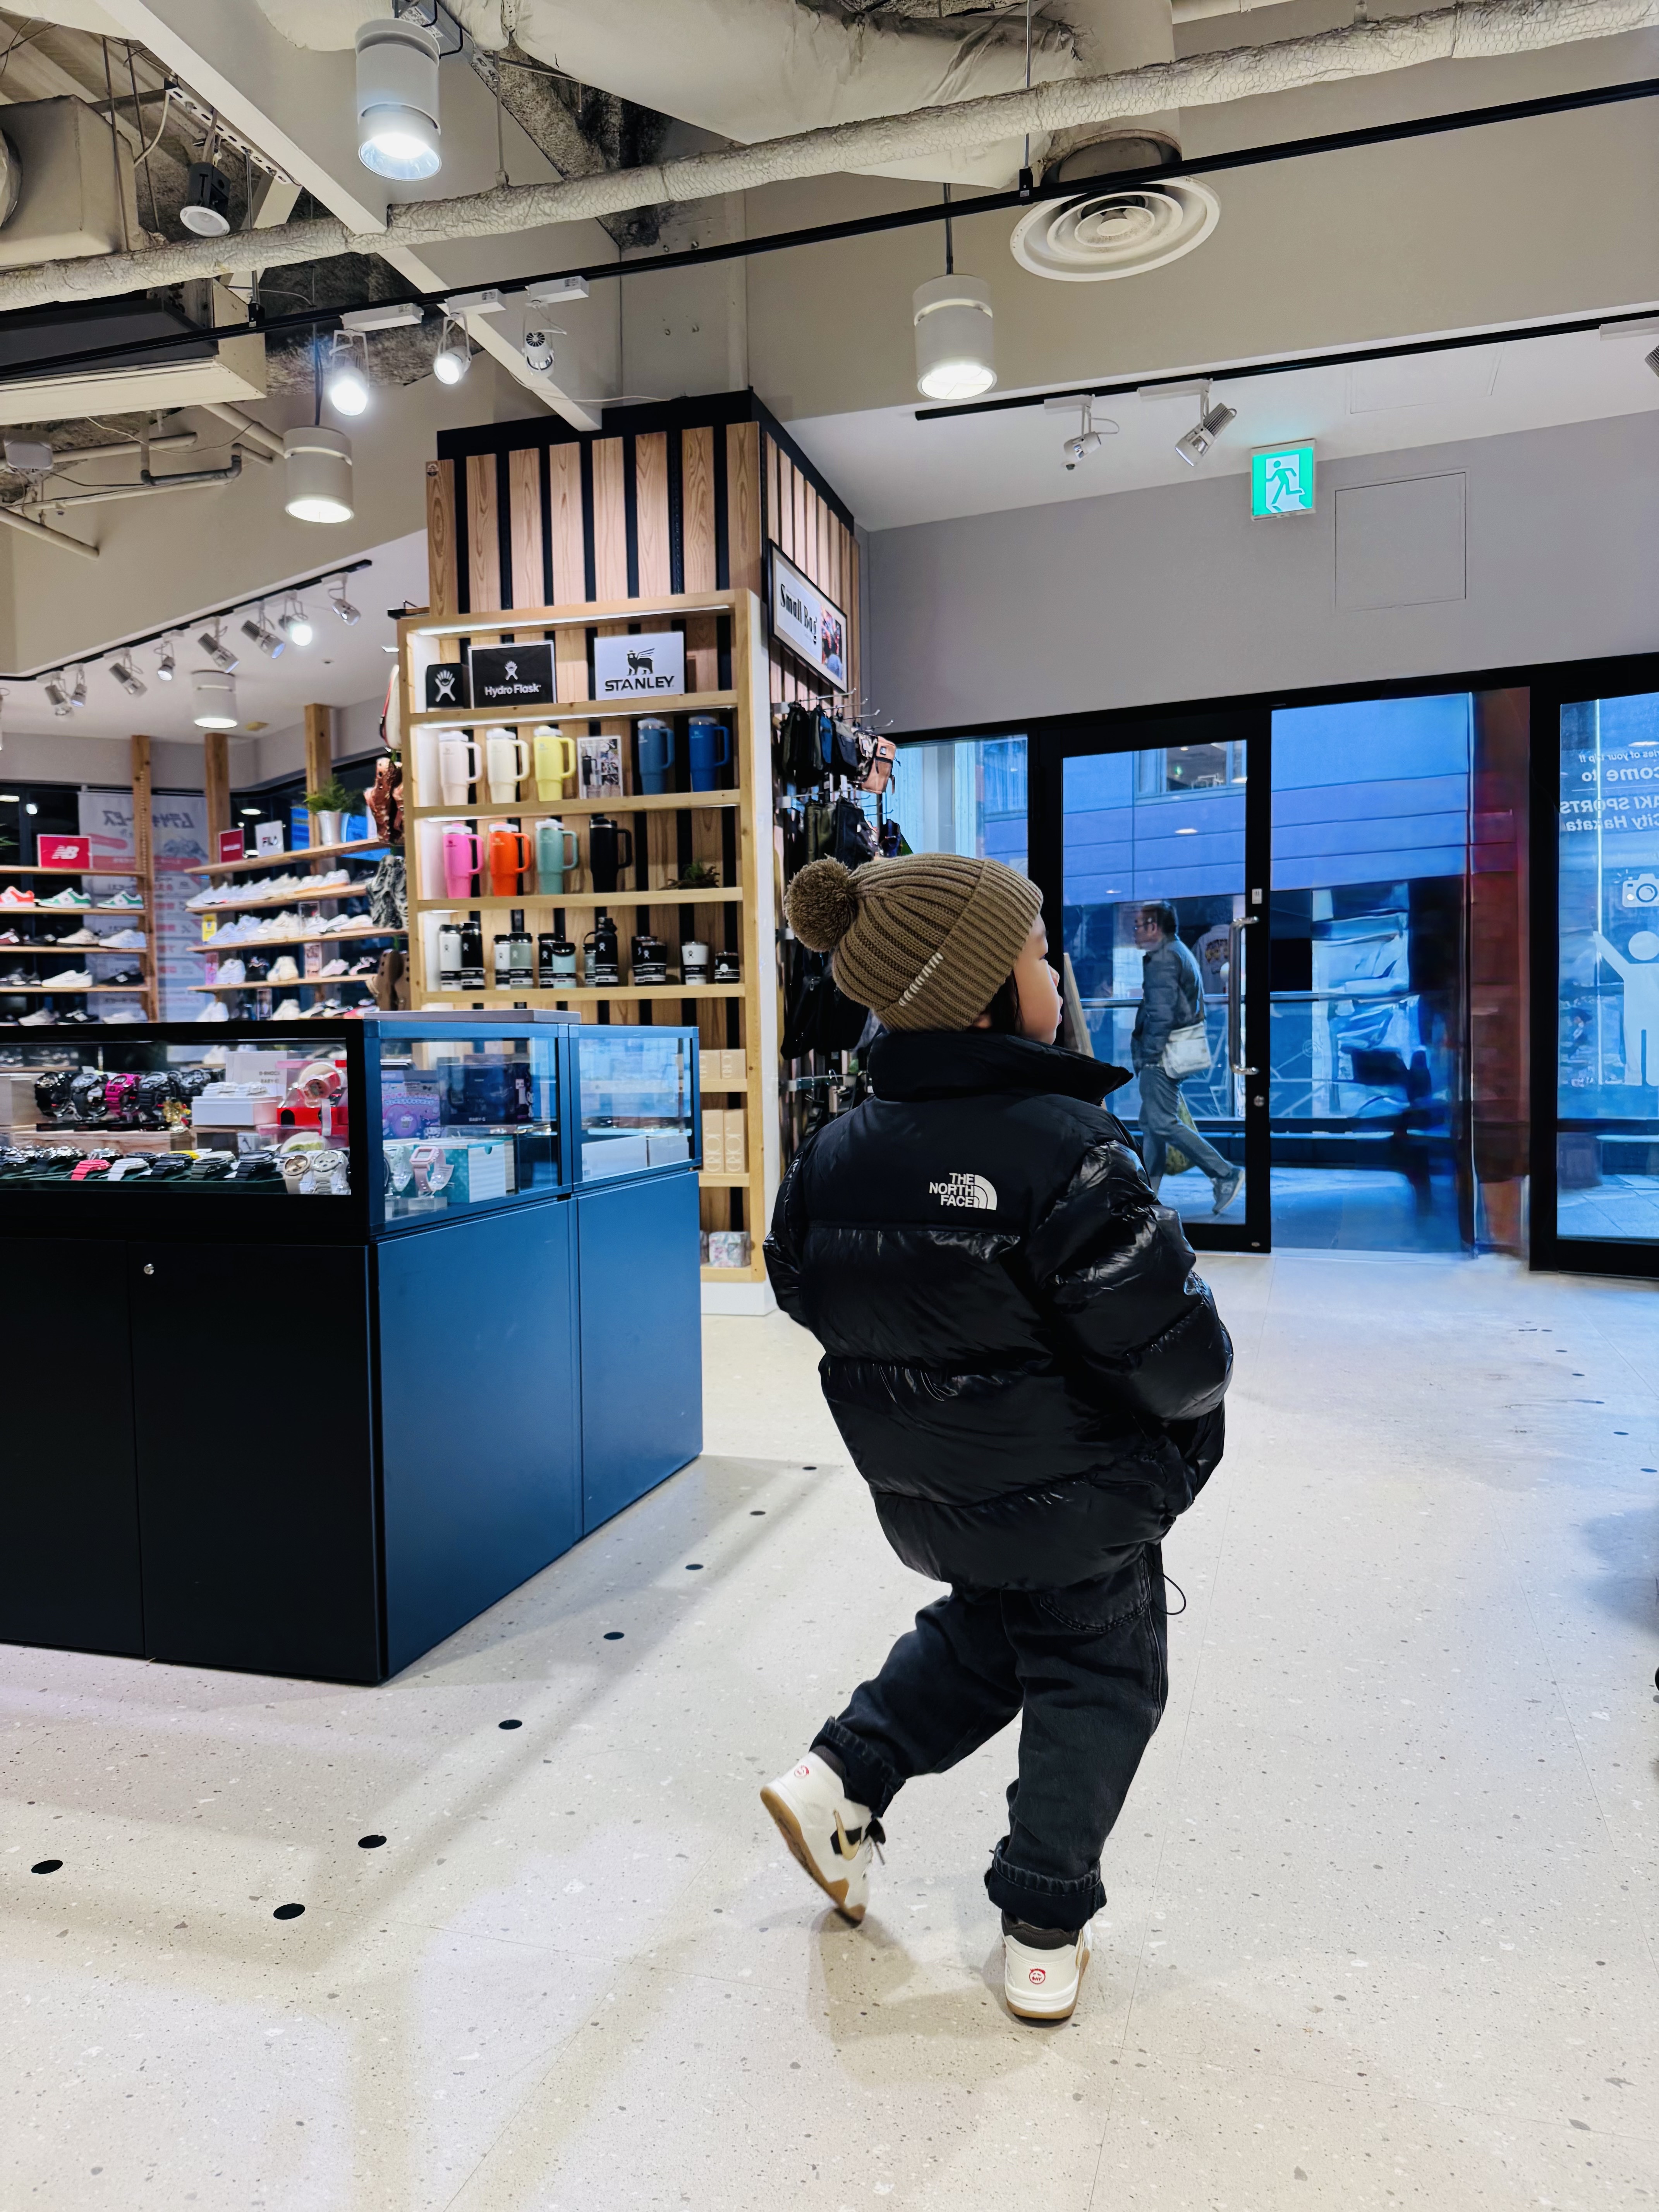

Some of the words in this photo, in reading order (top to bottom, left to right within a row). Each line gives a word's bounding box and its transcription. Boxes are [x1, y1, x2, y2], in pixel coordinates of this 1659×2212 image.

[780, 584, 802, 625] Small
[804, 605, 817, 645] Bag
[485, 685, 513, 697] Hydro
[514, 683, 539, 694] Flask
[605, 676, 675, 692] STANLEY
[705, 1127, 721, 1172] JORD
[725, 1127, 742, 1172] JORD
[949, 1172, 974, 1185] THE
[929, 1182, 974, 1197] NORTH
[940, 1195, 974, 1208] FACE
